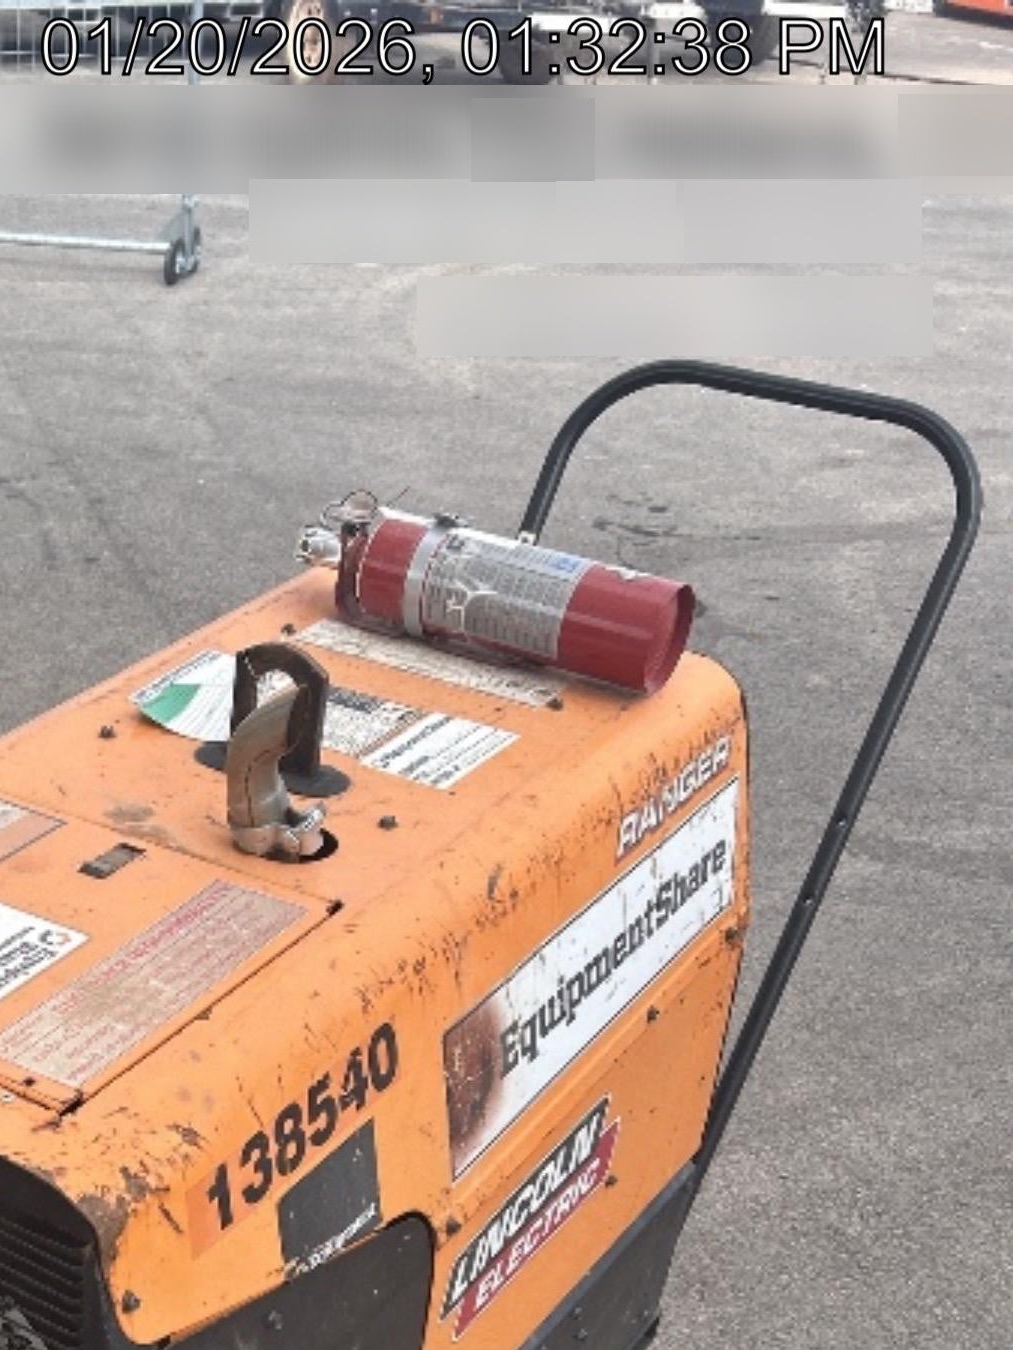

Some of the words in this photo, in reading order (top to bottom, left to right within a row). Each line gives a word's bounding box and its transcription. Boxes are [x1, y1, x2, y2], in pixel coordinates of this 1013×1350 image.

[615, 735, 731, 862] RANGER
[500, 839, 726, 1081] EquipmentShare
[206, 1021, 399, 1232] 138540
[451, 1112, 600, 1302] LINCOLN
[472, 1156, 601, 1314] ELECTRIC
